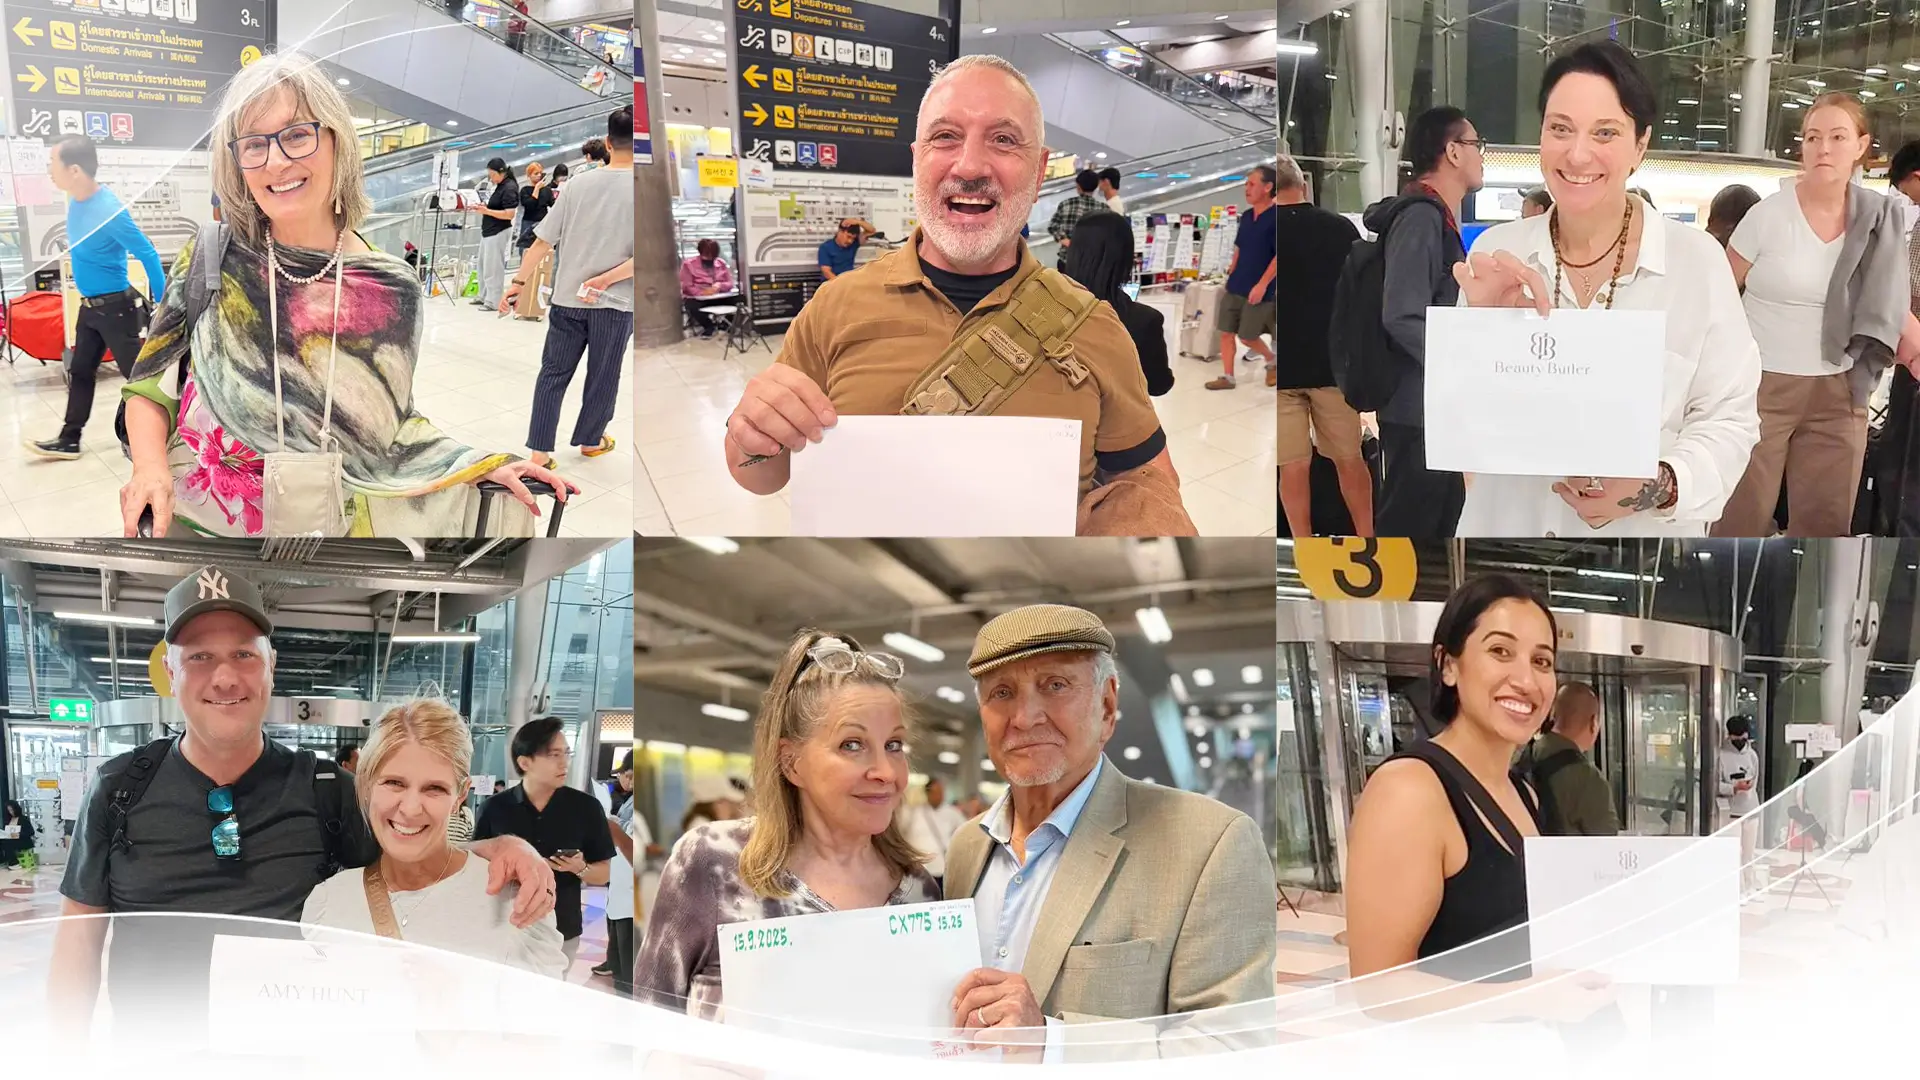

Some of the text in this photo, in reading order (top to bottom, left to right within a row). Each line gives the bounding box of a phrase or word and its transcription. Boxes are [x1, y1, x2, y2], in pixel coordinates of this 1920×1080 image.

[794, 12, 832, 26] Departures
[81, 42, 153, 59] Domestic Arrivals
[838, 47, 852, 55] CIP
[85, 87, 134, 99] International
[138, 91, 165, 101] Arrivals
[797, 85, 855, 100] Domestic Arrivals
[798, 122, 839, 132] International
[841, 125, 865, 135] Arrivals
[1495, 361, 1590, 377] Beauty Butler
[1331, 537, 1383, 598] 3
[197, 569, 231, 600] NY
[298, 701, 310, 720] 3
[889, 911, 932, 935] CX775
[258, 983, 371, 1004] AMY HUNT
